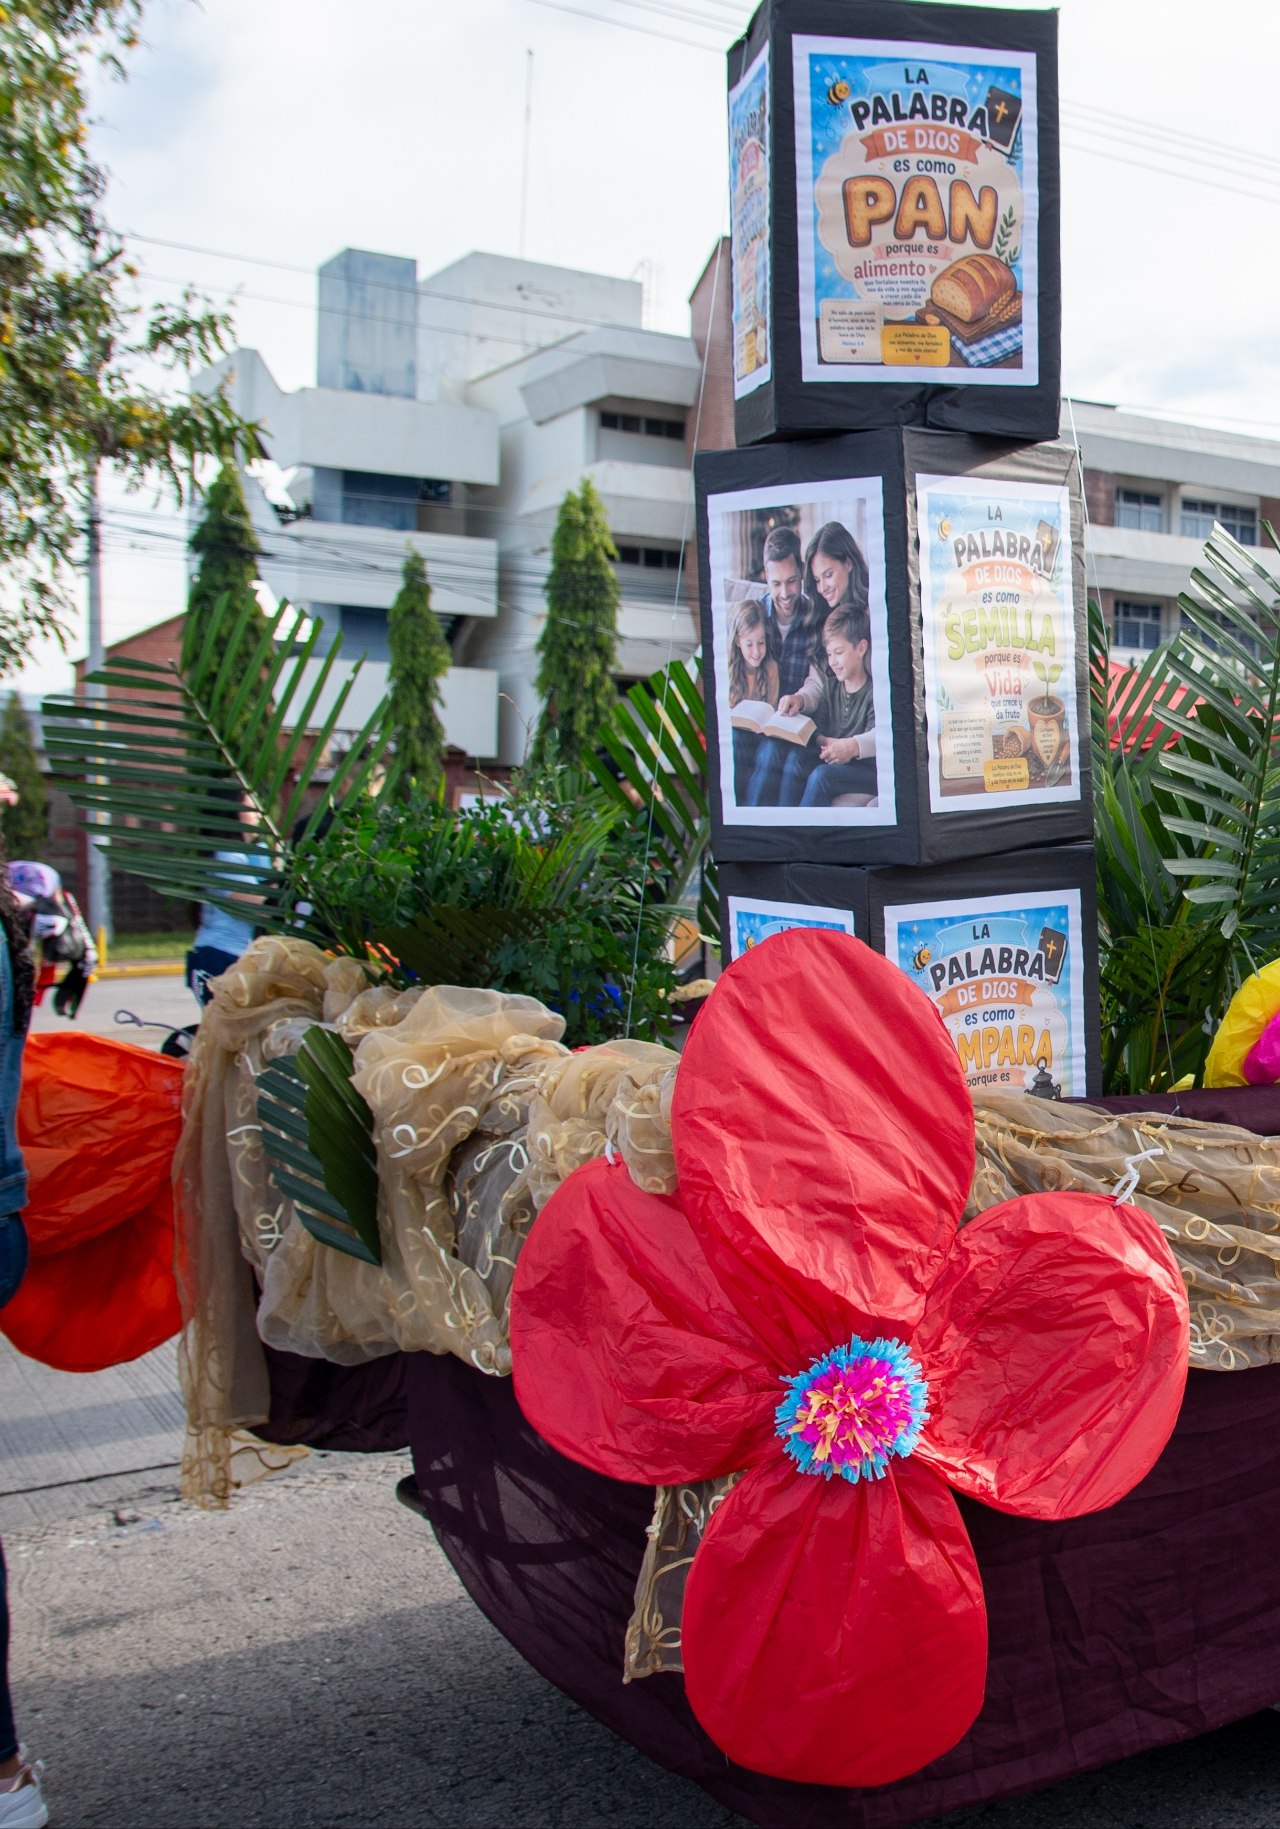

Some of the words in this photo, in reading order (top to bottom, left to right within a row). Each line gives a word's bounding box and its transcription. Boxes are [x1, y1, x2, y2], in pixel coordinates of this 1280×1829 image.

[904, 67, 929, 85] LA
[850, 92, 988, 138] PALABRA
[883, 131, 909, 152] DE
[914, 128, 961, 154] DIOS
[893, 159, 910, 173] es
[916, 159, 956, 175] como
[841, 174, 998, 250] PAN
[885, 243, 924, 257] porque
[927, 244, 939, 254] es
[854, 260, 926, 279] alimento
[987, 505, 1003, 521] LA
[953, 530, 1042, 570] PALABRA
[975, 567, 991, 585] DE
[994, 565, 1022, 585] DIOS
[982, 592, 993, 604] es
[996, 592, 1020, 604] como
[945, 606, 1056, 661] SEMILLA
[984, 653, 1011, 668] porque
[1013, 654, 1022, 664] es
[984, 669, 1022, 697] Vida
[991, 700, 1001, 709] que
[1003, 698, 1018, 707] crece
[1019, 698, 1023, 709] y
[995, 710, 1004, 720] da
[1004, 709, 1021, 719] fruto
[973, 924, 990, 940] LA
[929, 947, 1044, 992] PALABRA
[957, 985, 977, 1006] DE
[982, 981, 1018, 1000] DIOS
[964, 1012, 978, 1026] es
[982, 1008, 1015, 1022] como
[957, 1024, 1052, 1073] MPARA
[1000, 1072, 1010, 1081] es
